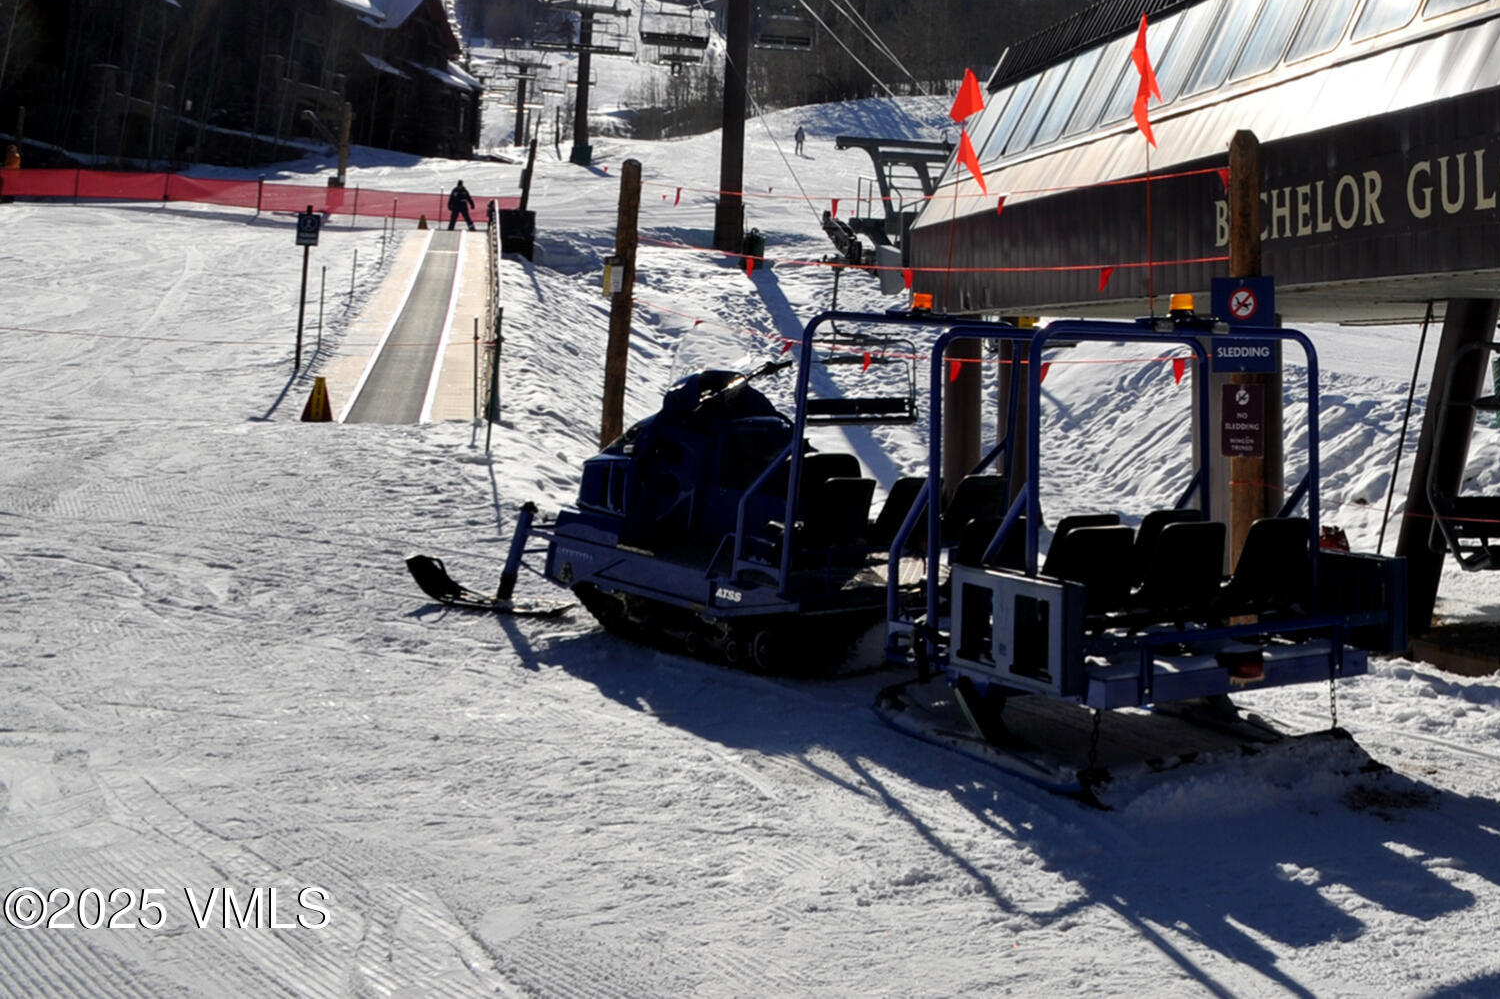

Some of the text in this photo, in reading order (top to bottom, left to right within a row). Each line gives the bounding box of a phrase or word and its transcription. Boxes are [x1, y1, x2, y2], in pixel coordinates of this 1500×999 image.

[1214, 170, 1385, 247] BHELOR
[1217, 346, 1270, 358] SLEDDING
[1224, 422, 1260, 431] SLEDDING
